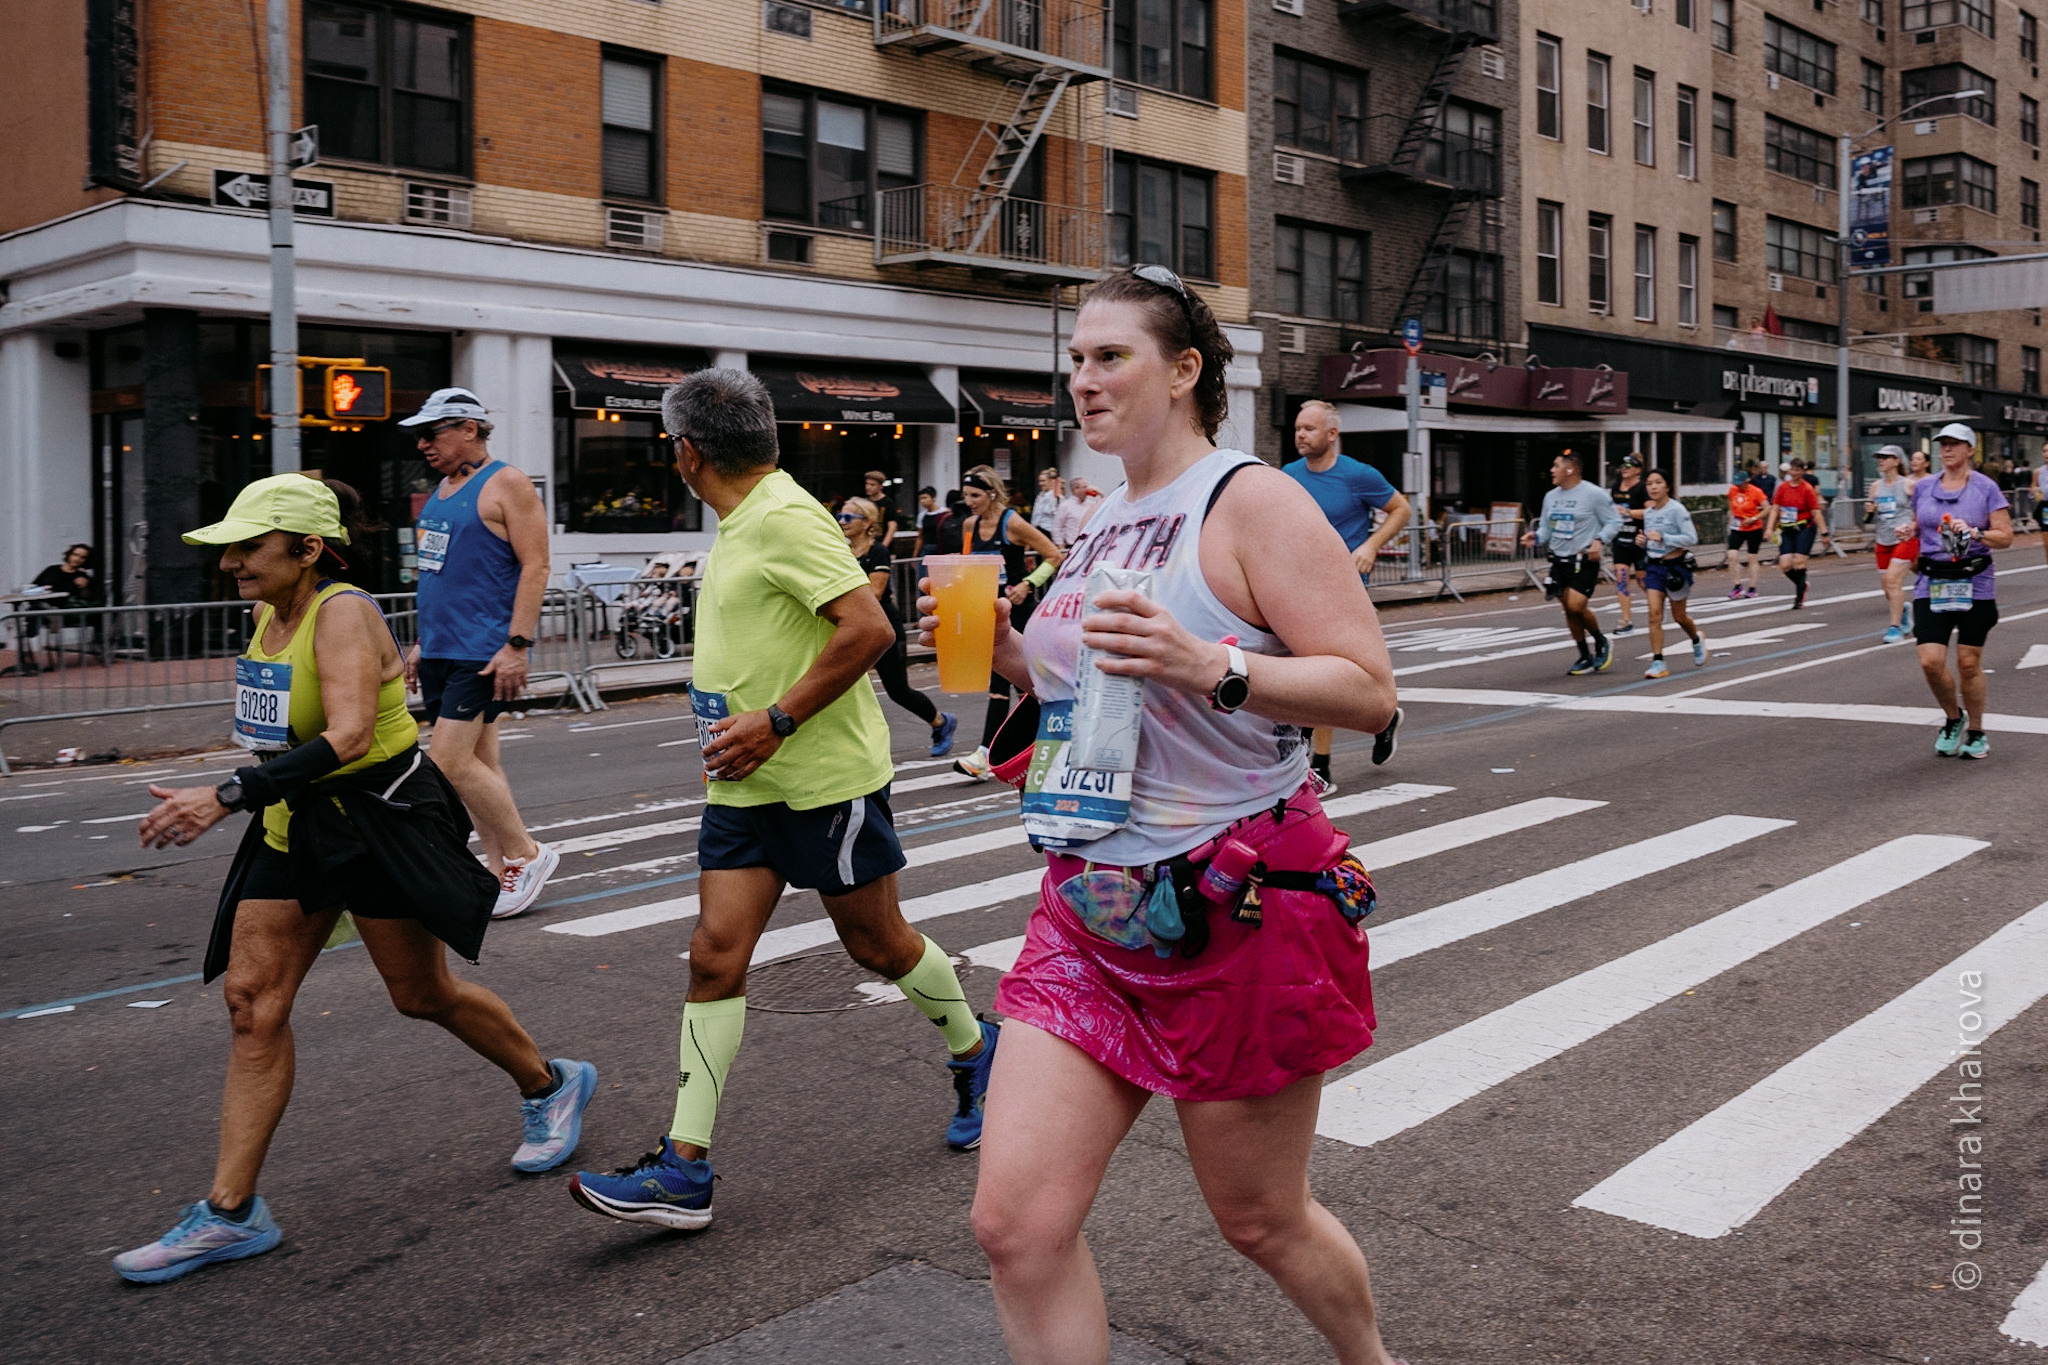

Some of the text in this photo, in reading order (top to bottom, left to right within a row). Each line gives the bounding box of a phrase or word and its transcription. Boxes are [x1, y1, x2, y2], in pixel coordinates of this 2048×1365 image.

[233, 182, 320, 201] ONE AY
[1740, 364, 1808, 406] pharmacy
[605, 395, 662, 408] ESTABLIS
[841, 410, 895, 421] WINE BAR
[241, 689, 278, 723] 61288
[1039, 745, 1050, 761] 5
[1033, 769, 1044, 786] C
